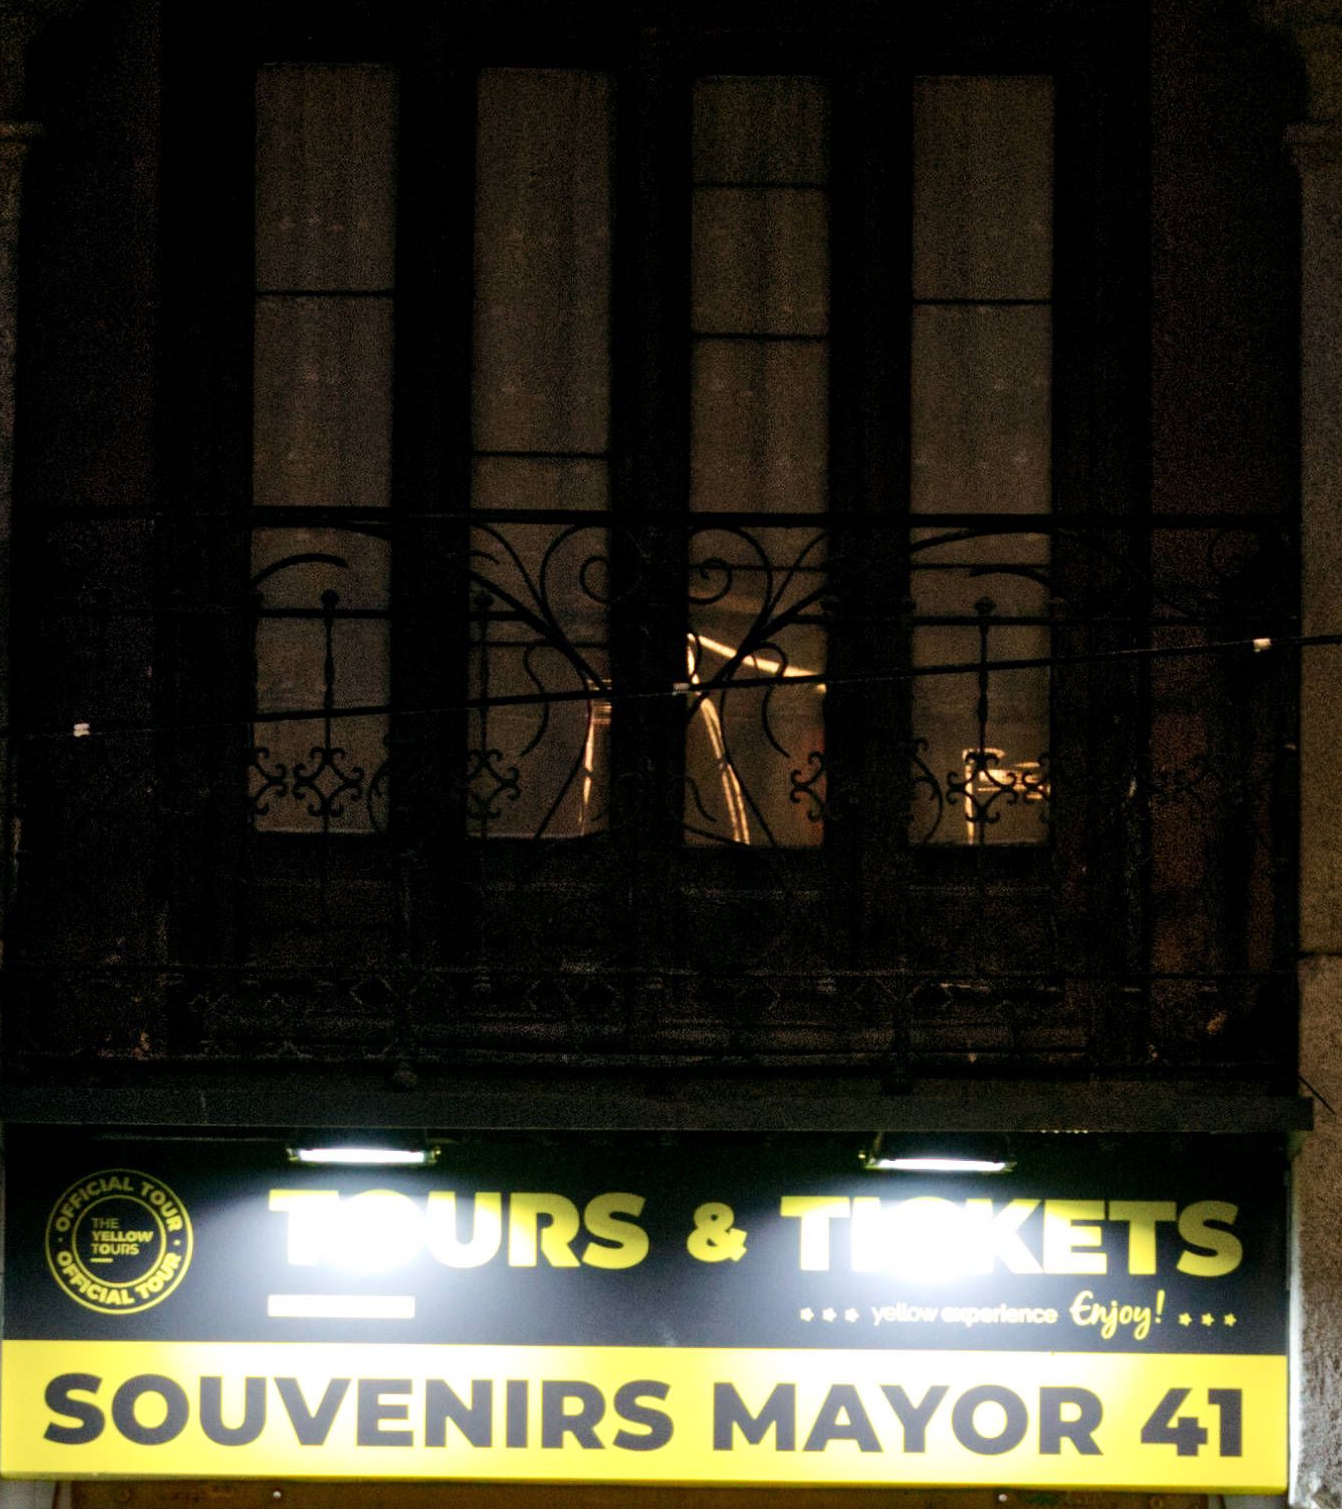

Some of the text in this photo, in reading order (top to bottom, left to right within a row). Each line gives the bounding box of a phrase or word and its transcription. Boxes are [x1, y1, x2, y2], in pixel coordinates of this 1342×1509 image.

[55, 1176, 182, 1232] OFFICIAL TOUR
[91, 1218, 118, 1229] THE
[91, 1231, 153, 1242] YELLOW
[91, 1244, 139, 1255] TOURS
[268, 1189, 1244, 1277] TOURS & TIKETS
[57, 1251, 181, 1305] OFFICIAL TOUR
[871, 1289, 1164, 1340] yellow experience Enjoy!
[42, 1373, 1243, 1459] SOUVENIRS MAYOR 41
